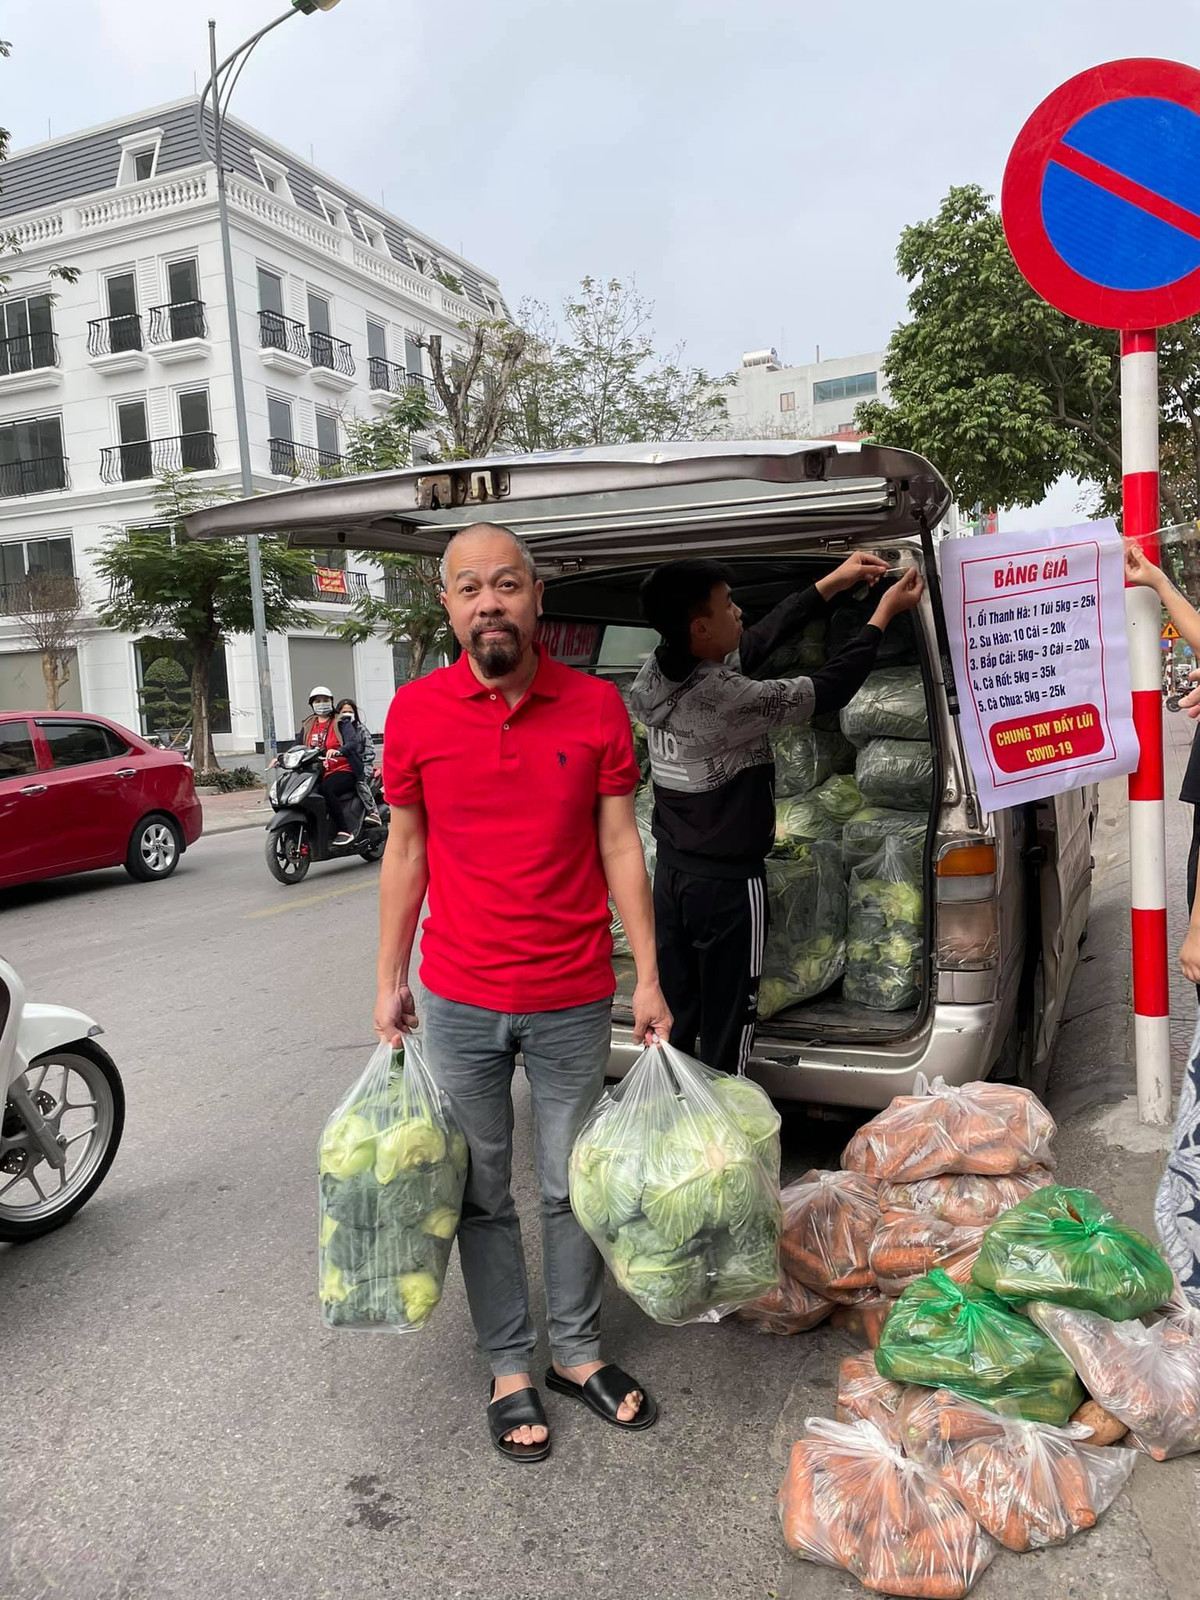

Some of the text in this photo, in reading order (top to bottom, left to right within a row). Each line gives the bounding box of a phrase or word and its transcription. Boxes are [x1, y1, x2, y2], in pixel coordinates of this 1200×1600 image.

[994, 554, 1068, 589] BẢNG GIÁ
[967, 616, 975, 628] 1.
[989, 609, 1014, 624] Thanh
[1033, 605, 1037, 616] 1
[1041, 602, 1053, 615] Túi
[1055, 600, 1070, 612] 5kg
[1081, 594, 1096, 608] 25k
[969, 637, 977, 650] 2.
[980, 635, 991, 648] Su
[1013, 628, 1024, 641] 10
[1050, 621, 1066, 635] 20k
[970, 658, 978, 670] 3.
[980, 652, 997, 669] Bắp
[1042, 645, 1048, 657] 3
[1074, 637, 1090, 651] 20k
[973, 680, 982, 691] 4.
[1014, 671, 1030, 683] 5kg
[1032, 671, 1038, 679] =
[1040, 665, 1057, 679] 35k
[978, 700, 987, 713] 5.
[998, 694, 1023, 708] Chua:
[1024, 689, 1040, 703] 5kg
[1041, 690, 1048, 698] =
[1049, 684, 1066, 697] 25k
[996, 727, 1032, 747] CHUNG
[1032, 722, 1050, 738] TAY
[1026, 741, 1074, 763] COVID-19
